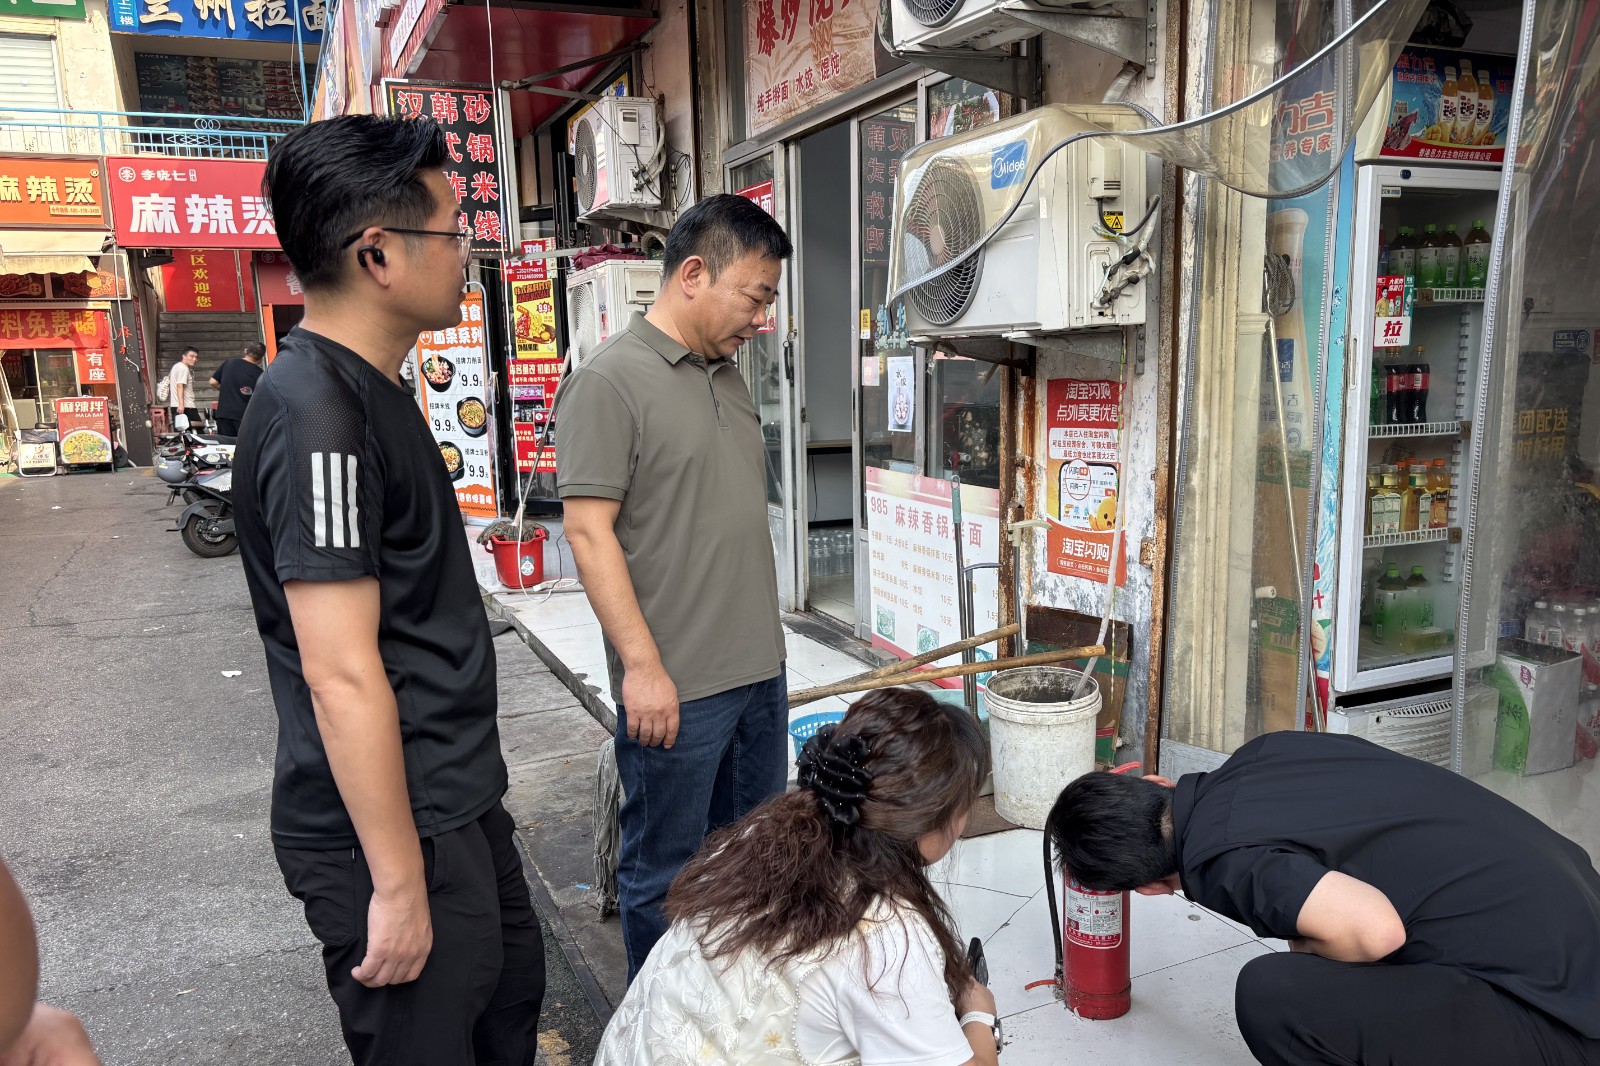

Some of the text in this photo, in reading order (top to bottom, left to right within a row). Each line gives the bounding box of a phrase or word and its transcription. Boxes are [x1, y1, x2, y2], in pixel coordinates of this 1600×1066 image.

[757, 54, 841, 113] 纯手擀面 水饺 馄饨
[463, 93, 502, 242] 砂锅米线
[994, 157, 1026, 179] Midea
[0, 174, 96, 203] 麻辣烫
[130, 193, 277, 235] 麻辣烫
[190, 247, 212, 308] 区欢迎您
[1, 310, 97, 338] 料免费喝
[1383, 320, 1403, 338] 拉
[433, 326, 482, 345] 面条系列
[1384, 336, 1399, 344] PULL
[455, 356, 482, 365] 招牌刀削面
[1065, 381, 1112, 400] 淘宝闪购
[60, 401, 104, 413] 麻辣拌
[1056, 403, 1119, 423] 点外卖更优惠
[871, 496, 888, 515] 985
[941, 552, 954, 564] 10元
[1062, 537, 1110, 561] 淘宝闪购
[941, 574, 954, 586] 10元
[940, 594, 953, 606] 10元
